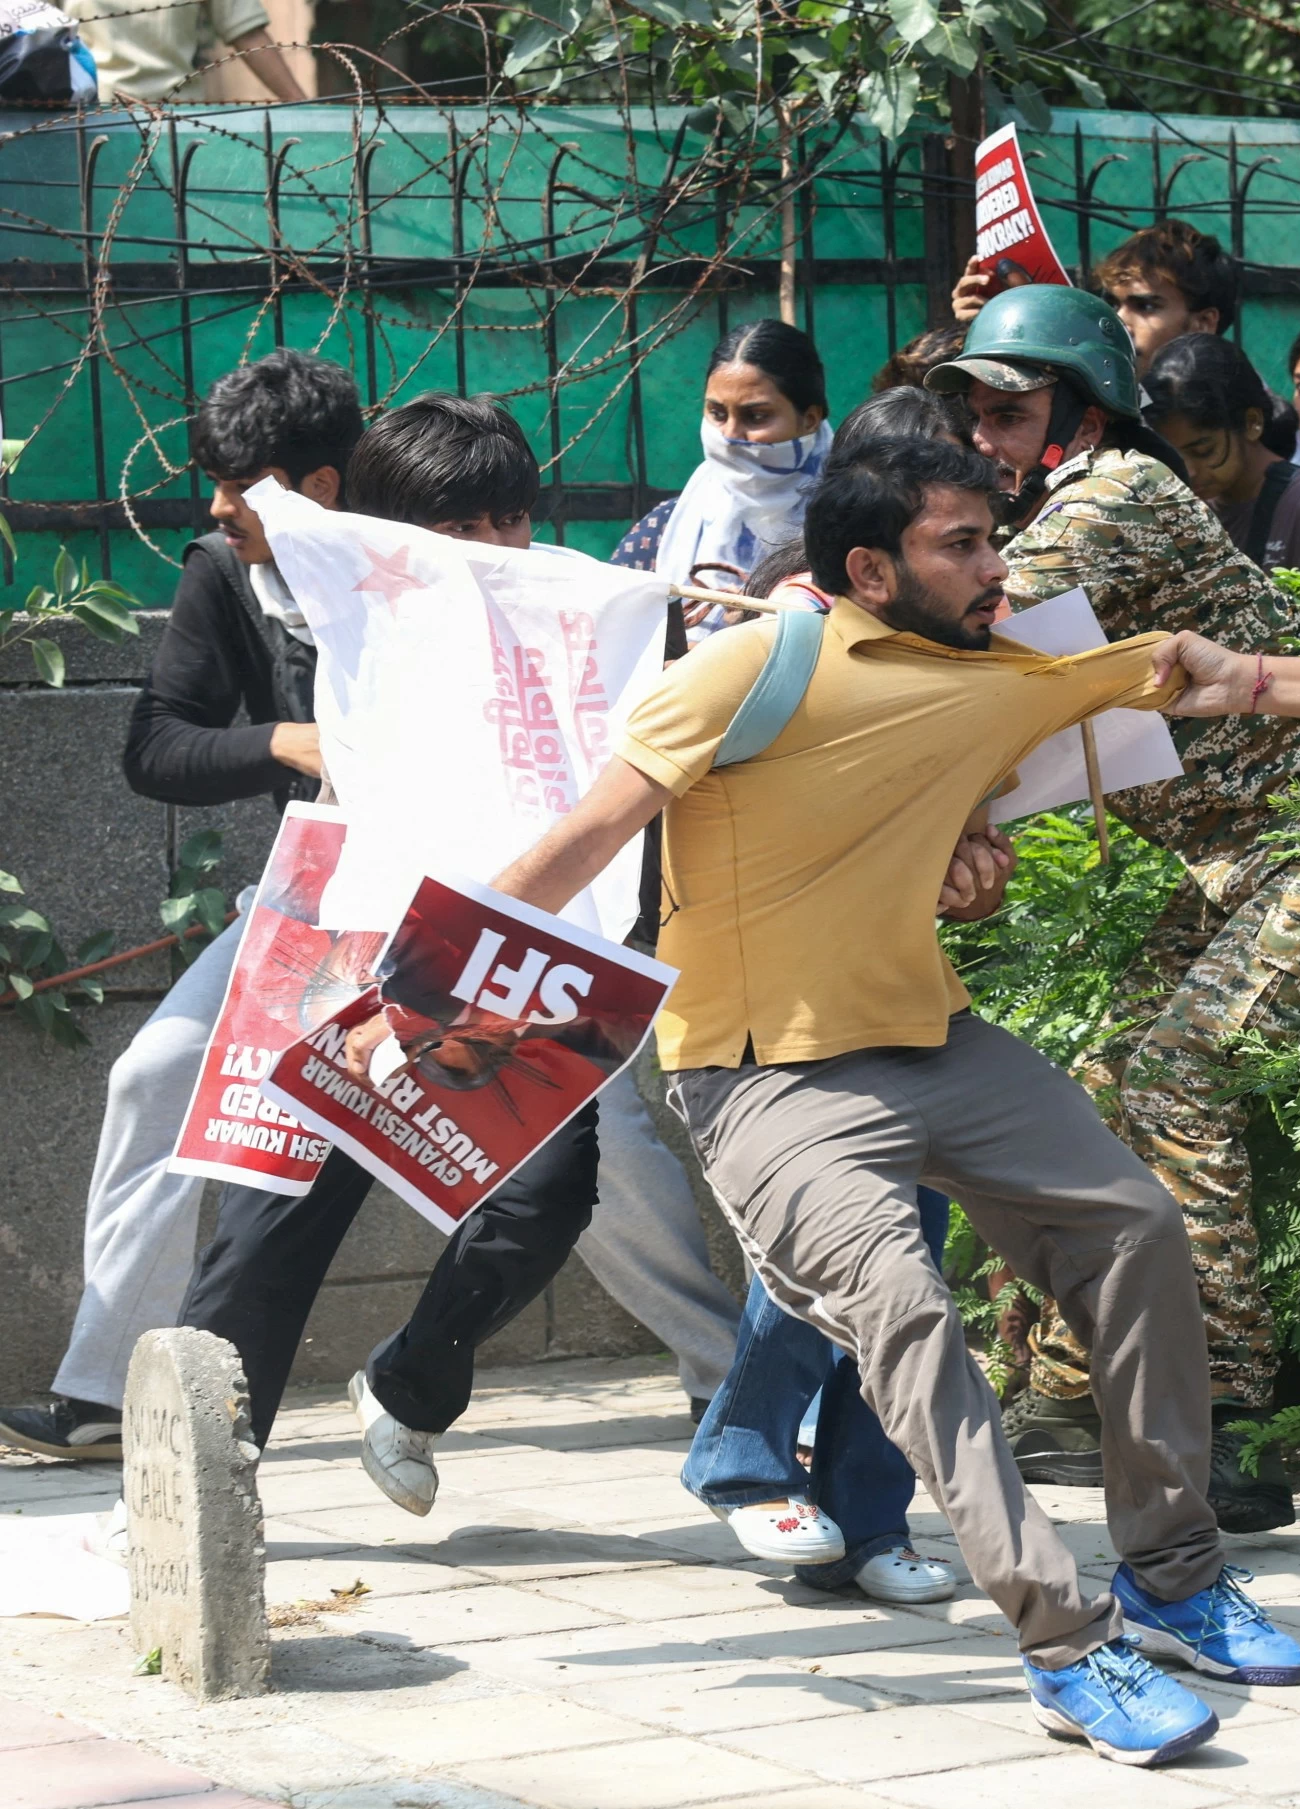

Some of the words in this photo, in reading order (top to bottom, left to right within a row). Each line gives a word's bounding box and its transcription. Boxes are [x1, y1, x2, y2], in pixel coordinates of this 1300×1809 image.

[450, 928, 595, 1025] SFI
[220, 1043, 282, 1081] CY!
[301, 1054, 378, 1120] KUMAR
[204, 1118, 288, 1155] KUMAR
[219, 1083, 317, 1134] ERED
[370, 1103, 463, 1187] GYANESH
[411, 1103, 500, 1185] MUST
